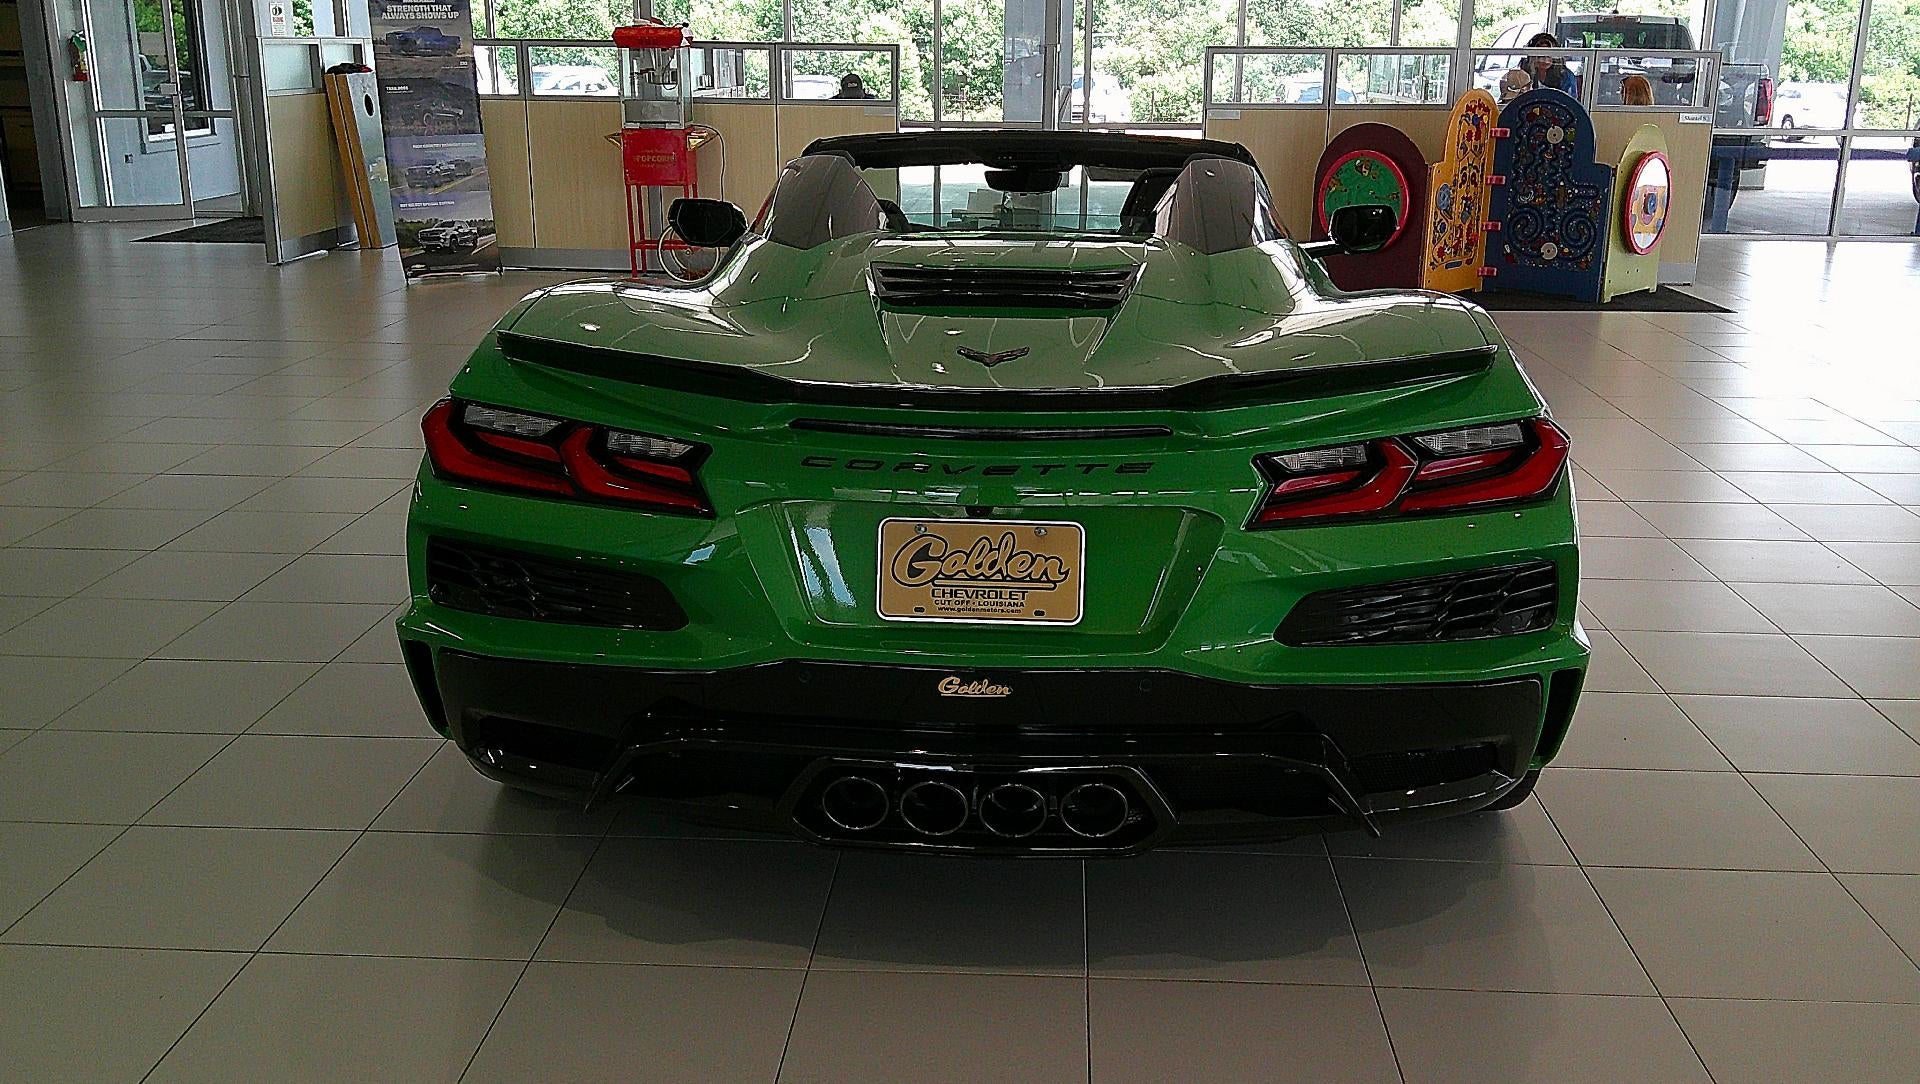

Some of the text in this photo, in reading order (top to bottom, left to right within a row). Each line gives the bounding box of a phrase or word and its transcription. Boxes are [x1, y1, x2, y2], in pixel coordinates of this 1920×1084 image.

[416, 11, 447, 19] SHOWS
[448, 11, 459, 19] UP
[800, 455, 1155, 476] CORVETTE
[891, 531, 1071, 588] Golden
[931, 588, 1029, 601] CHEVROLET
[937, 606, 1022, 614] www.goldenmotors.com
[978, 600, 1025, 608] LOUISIANA
[937, 676, 1011, 695] Golden
